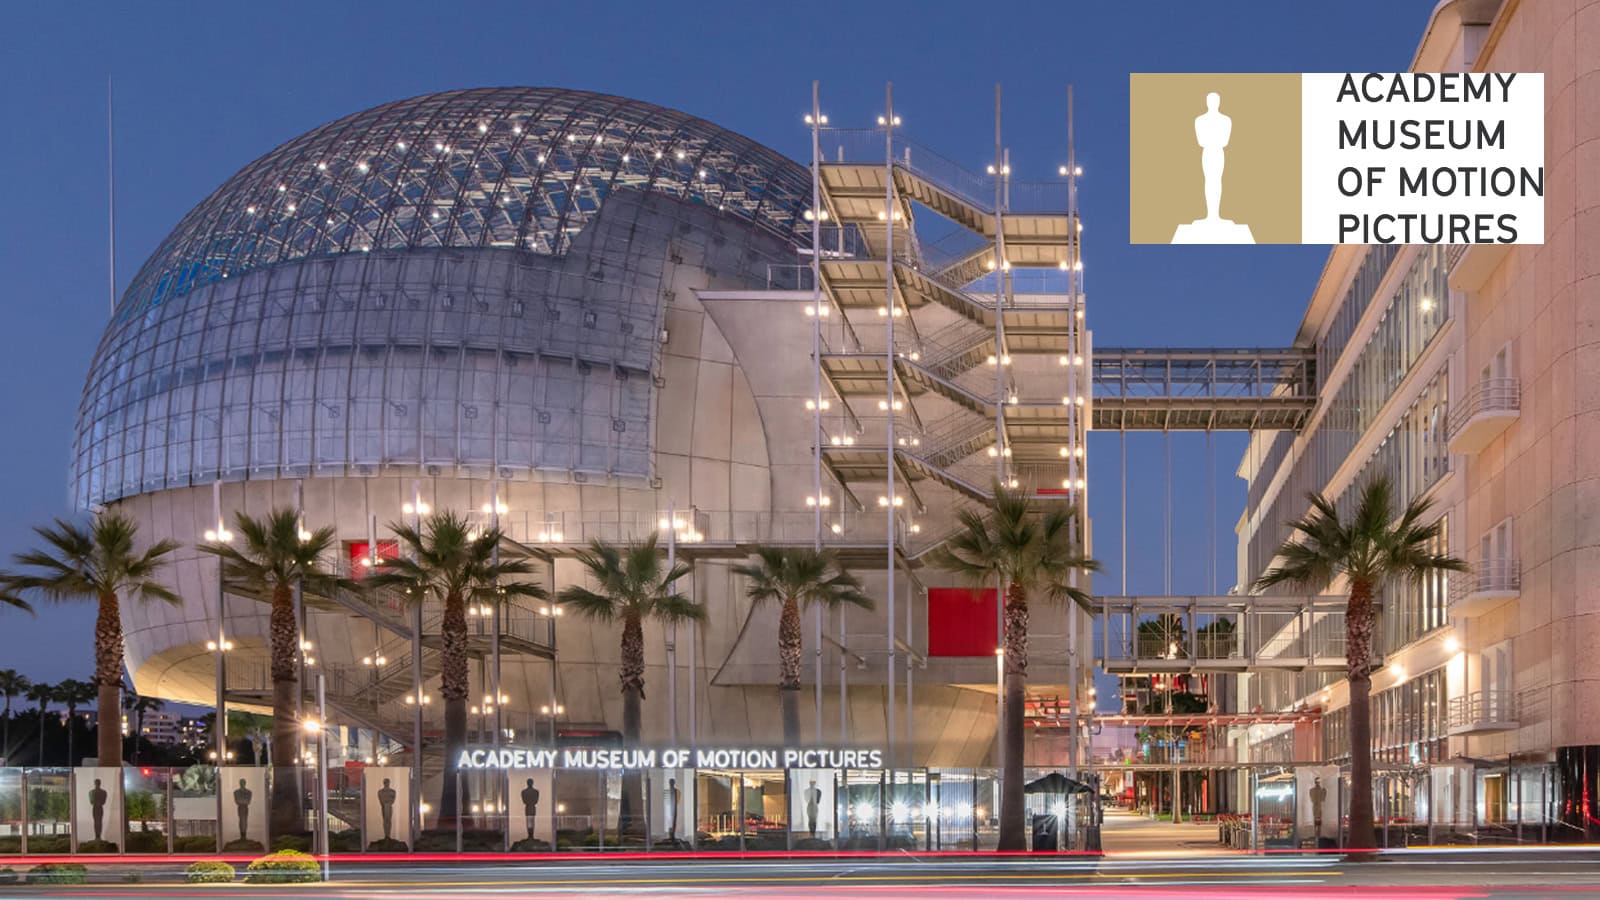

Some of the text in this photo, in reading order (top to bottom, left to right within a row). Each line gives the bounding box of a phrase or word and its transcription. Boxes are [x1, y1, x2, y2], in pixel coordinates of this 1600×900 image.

[458, 749, 883, 769] ACADEMY MUSEUM OF MOTION PICTURES
